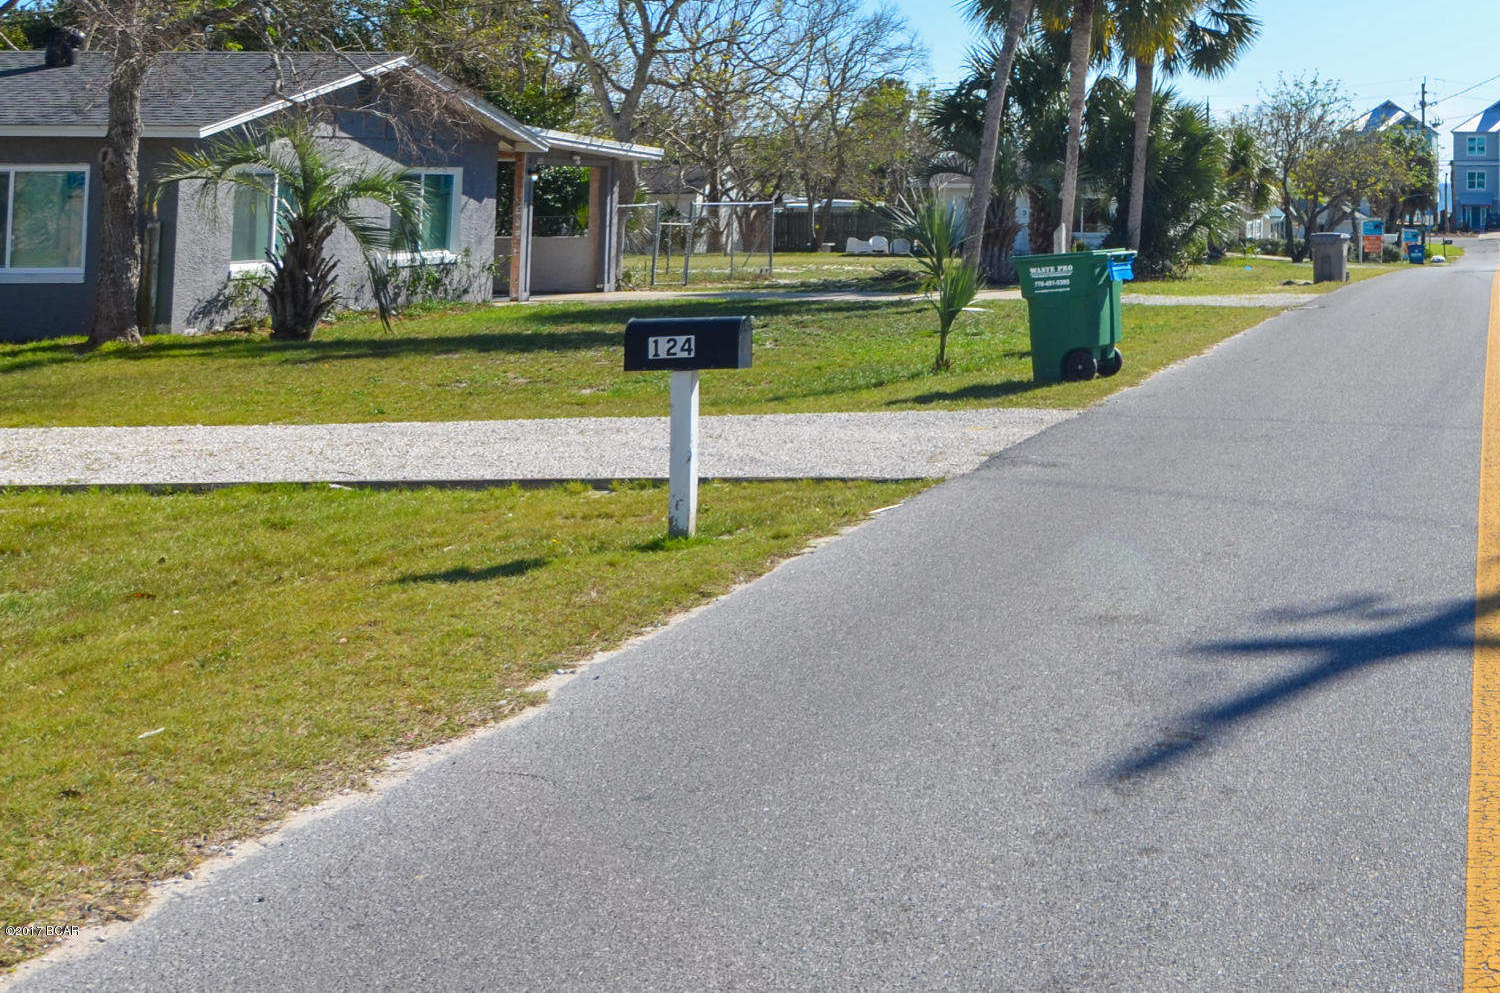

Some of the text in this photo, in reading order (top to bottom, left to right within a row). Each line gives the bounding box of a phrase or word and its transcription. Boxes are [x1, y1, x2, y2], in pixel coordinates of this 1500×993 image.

[1029, 264, 1073, 274] WASTE PRO
[652, 337, 693, 358] 124
